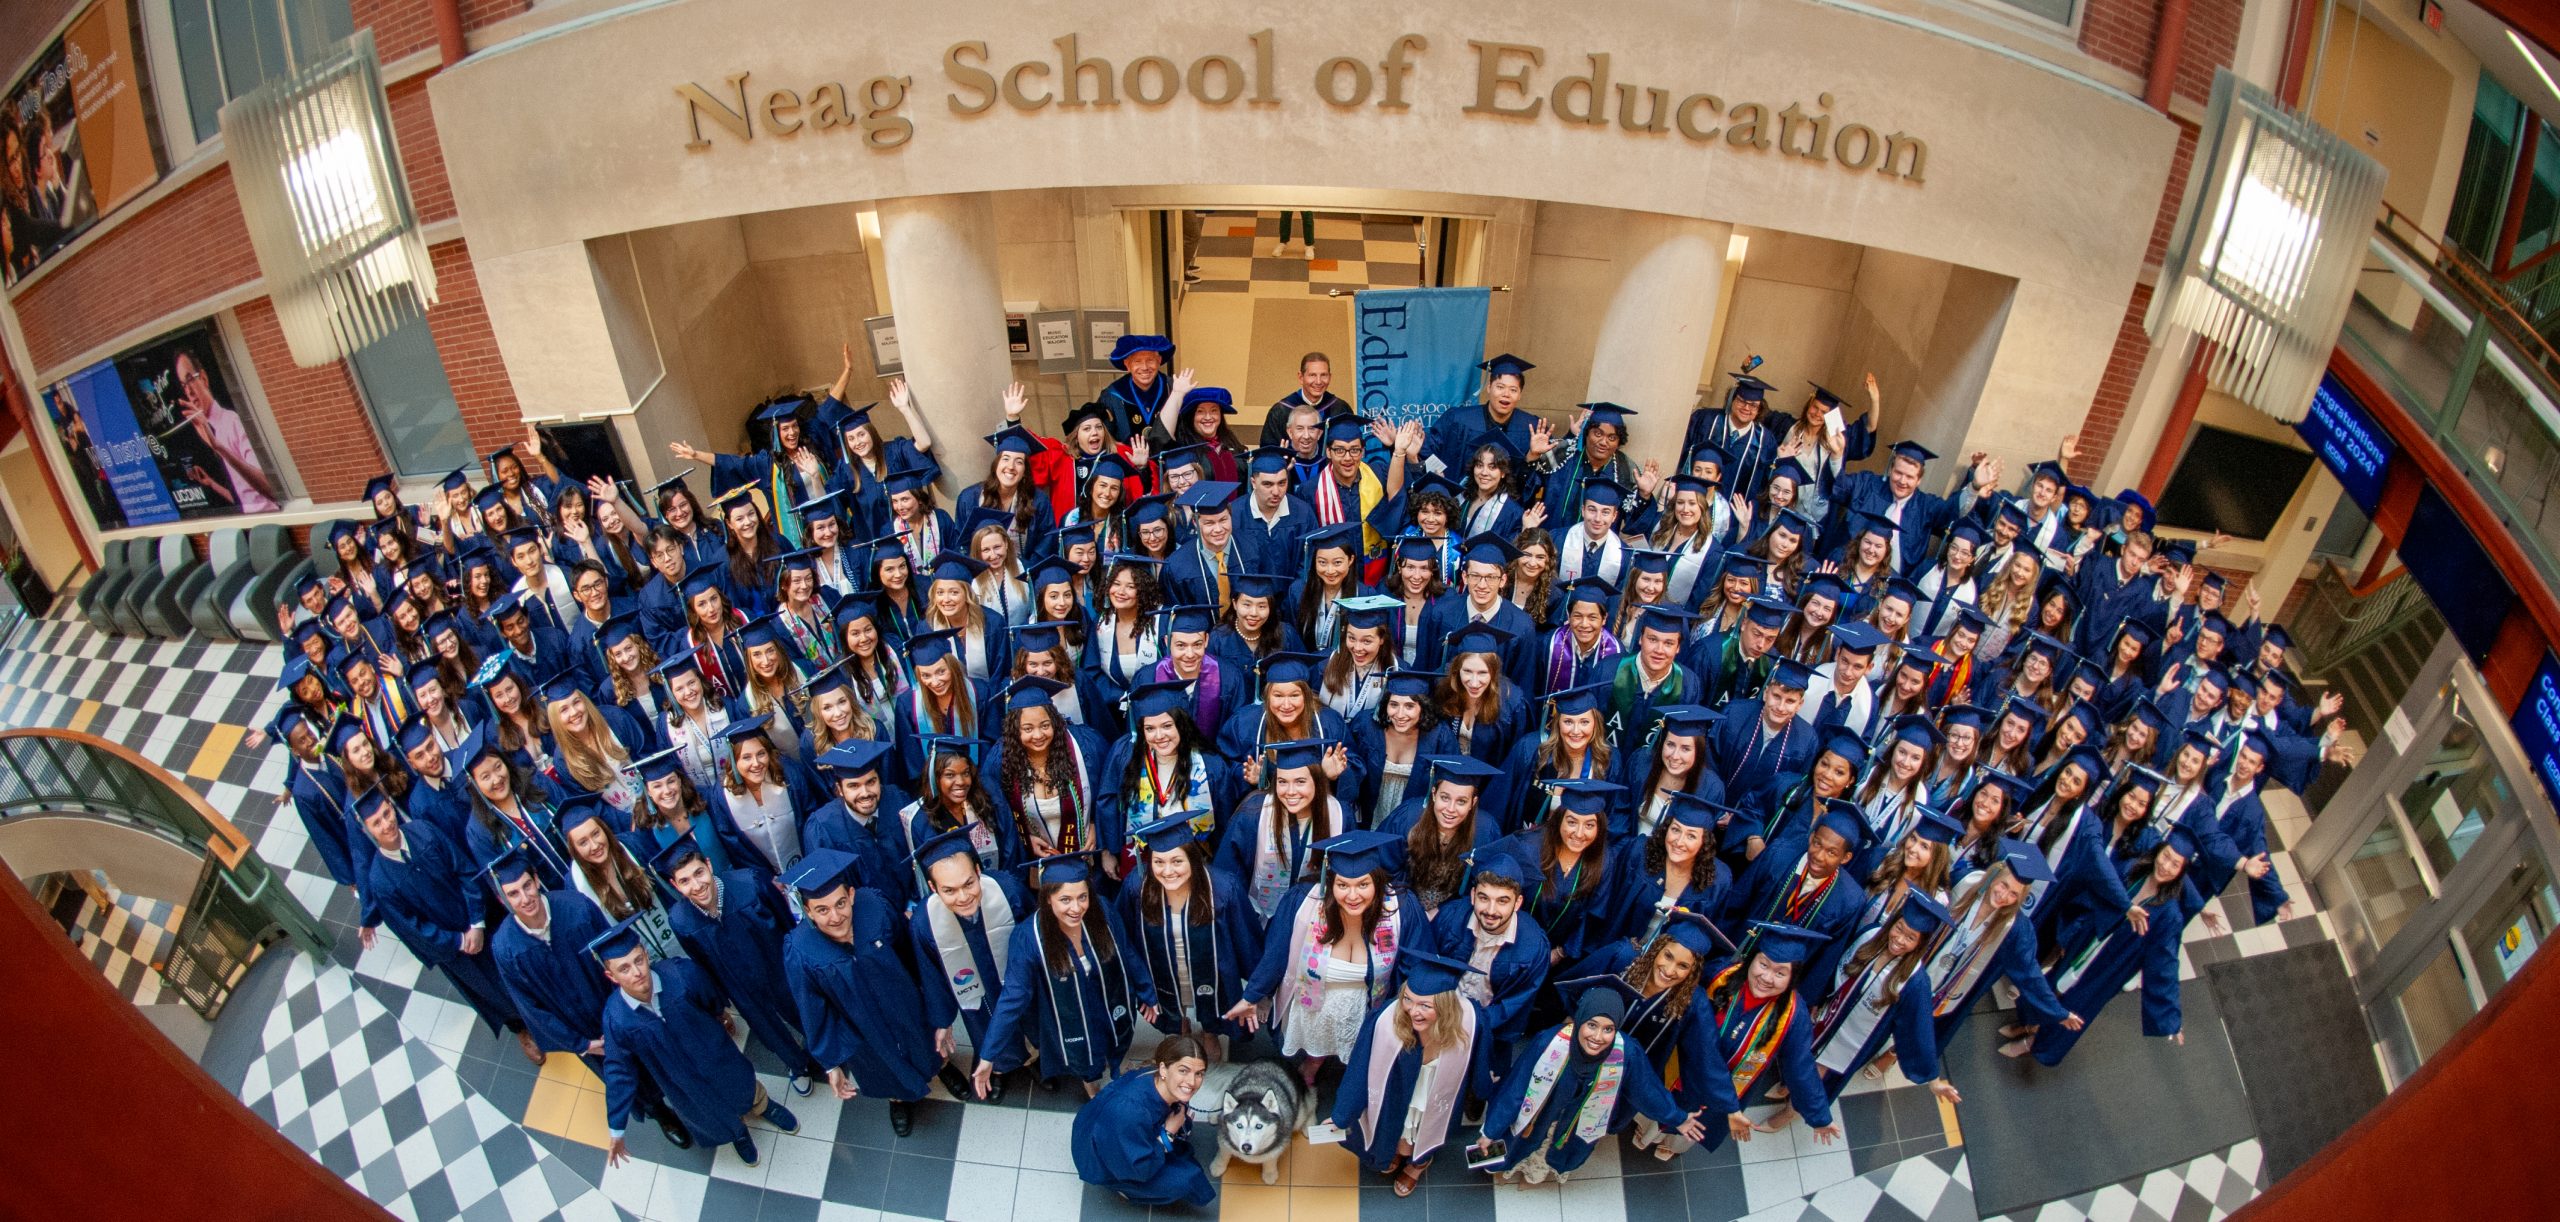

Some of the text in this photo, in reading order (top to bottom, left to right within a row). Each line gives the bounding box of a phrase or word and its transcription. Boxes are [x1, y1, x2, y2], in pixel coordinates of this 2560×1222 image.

[17, 42, 88, 125] We Teach,
[674, 28, 1927, 183] Neag School of Education
[1361, 406, 1397, 418] NEAG
[85, 432, 168, 470] We Inspire,
[2311, 398, 2377, 477] Class of 2024!
[2324, 441, 2349, 468] UCONN
[172, 487, 206, 503] UCONN
[1715, 690, 1729, 706] A
[957, 983, 979, 996] UCTV
